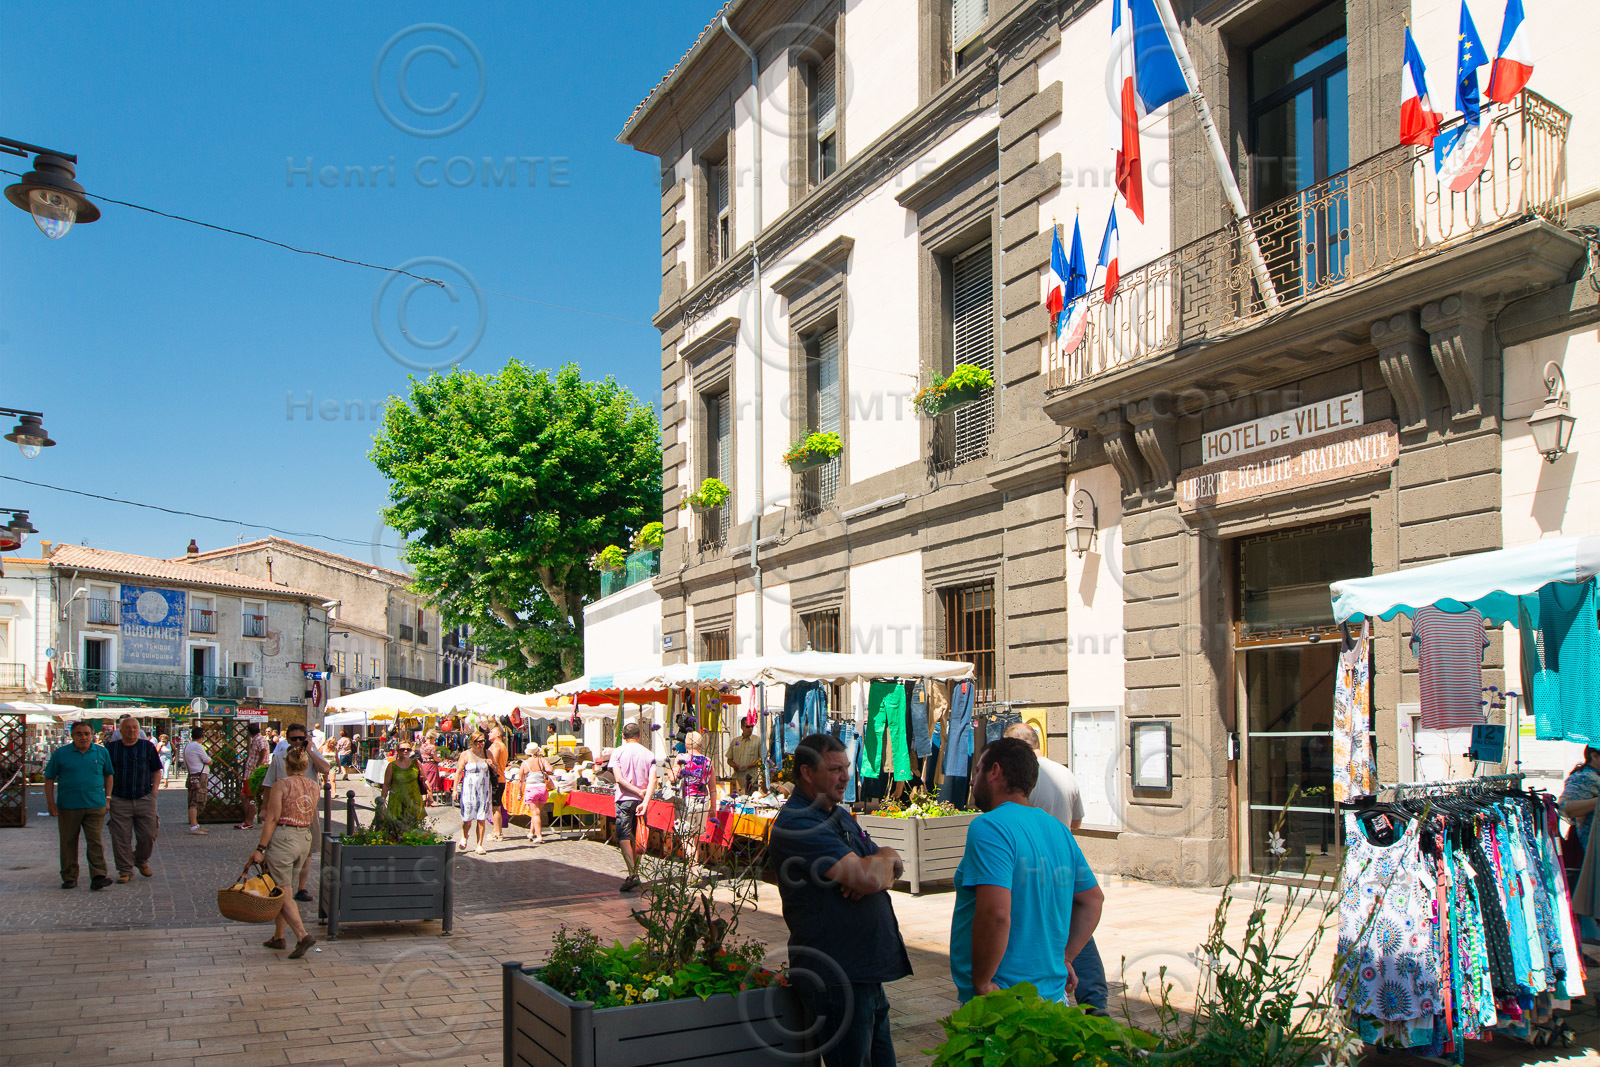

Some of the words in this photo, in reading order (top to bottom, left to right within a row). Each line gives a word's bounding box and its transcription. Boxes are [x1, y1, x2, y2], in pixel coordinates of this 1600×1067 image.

[1207, 424, 1266, 458] HOTEL
[1270, 426, 1290, 442] DE
[1295, 398, 1353, 436] VILLE
[1182, 470, 1230, 501] LIBERTE
[1238, 455, 1292, 490] EGALITE
[1300, 432, 1390, 475] FRATERNITE
[124, 623, 180, 641] DUBONNET
